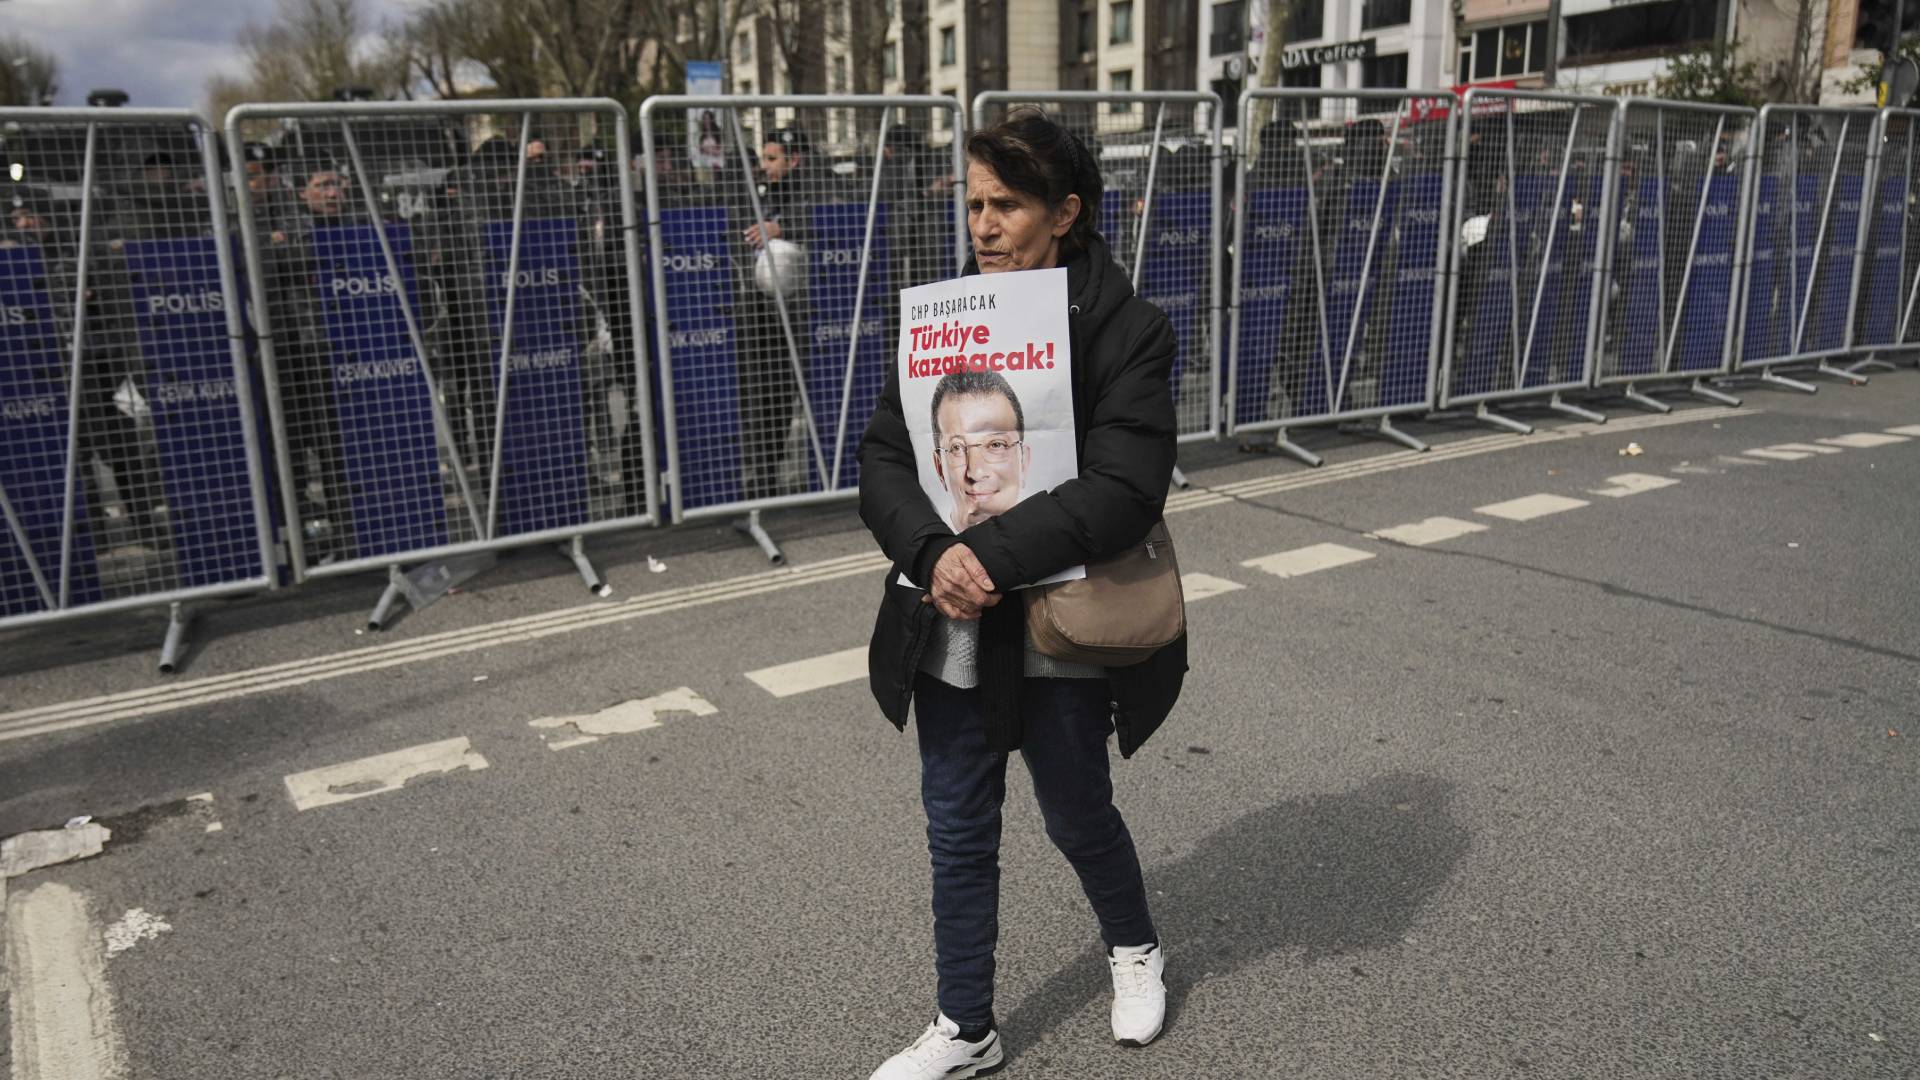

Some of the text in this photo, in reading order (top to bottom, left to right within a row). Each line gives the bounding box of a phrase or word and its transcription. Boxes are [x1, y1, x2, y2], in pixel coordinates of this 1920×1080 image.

[1313, 43, 1367, 65] Coffee
[331, 271, 398, 297] POLİS
[148, 287, 224, 315] POLİS
[912, 293, 997, 321] CHP BAŞARACAK
[910, 320, 991, 353] Türkiye
[908, 342, 1055, 379] kazanacak!
